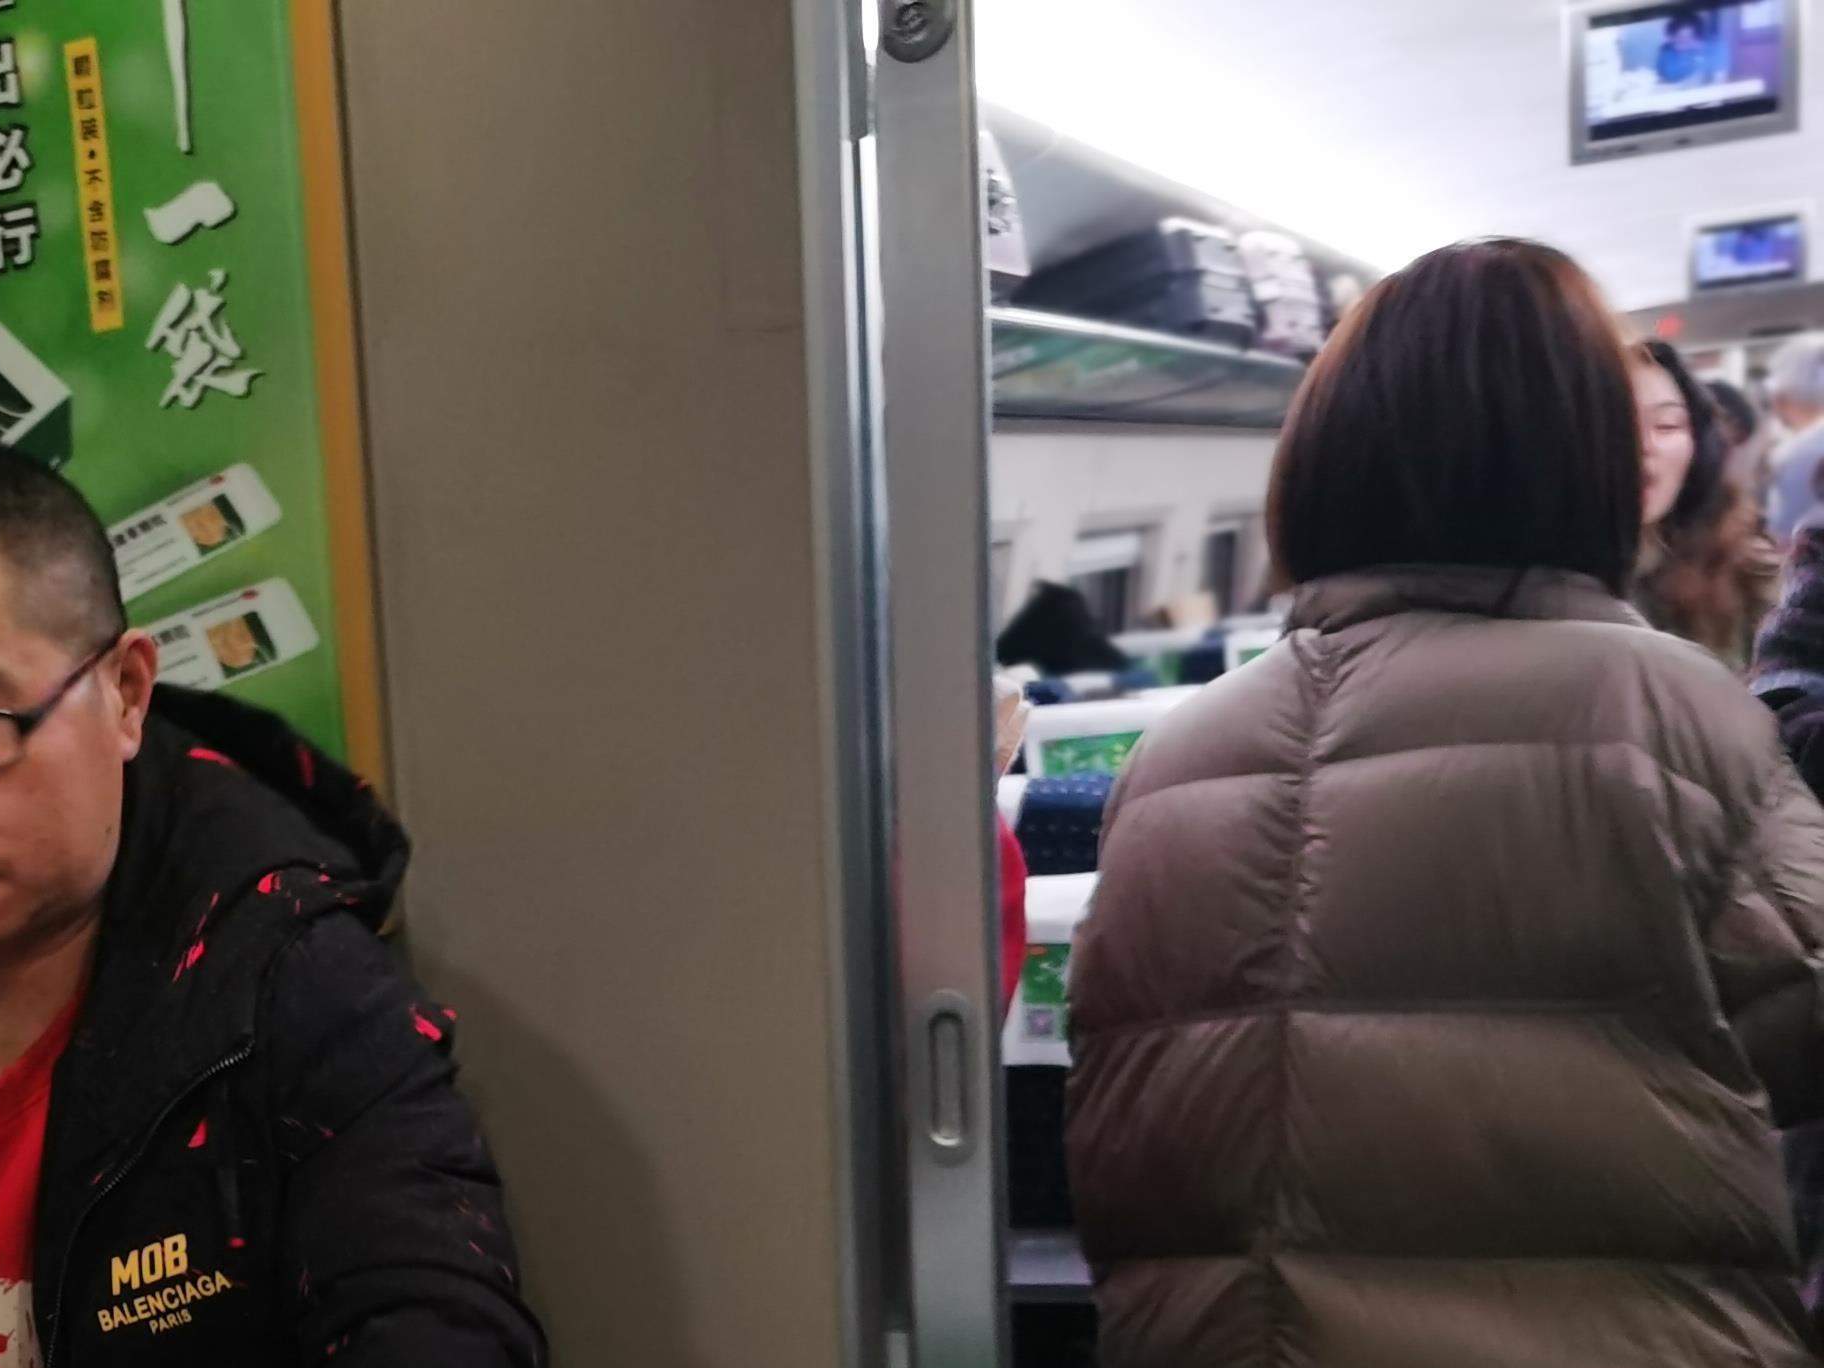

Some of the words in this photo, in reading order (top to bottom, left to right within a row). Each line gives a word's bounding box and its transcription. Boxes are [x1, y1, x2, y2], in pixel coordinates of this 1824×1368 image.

[110, 1234, 189, 1296] MOB
[97, 1270, 233, 1332] BALENCIAGA
[149, 1309, 193, 1335] PARIS
